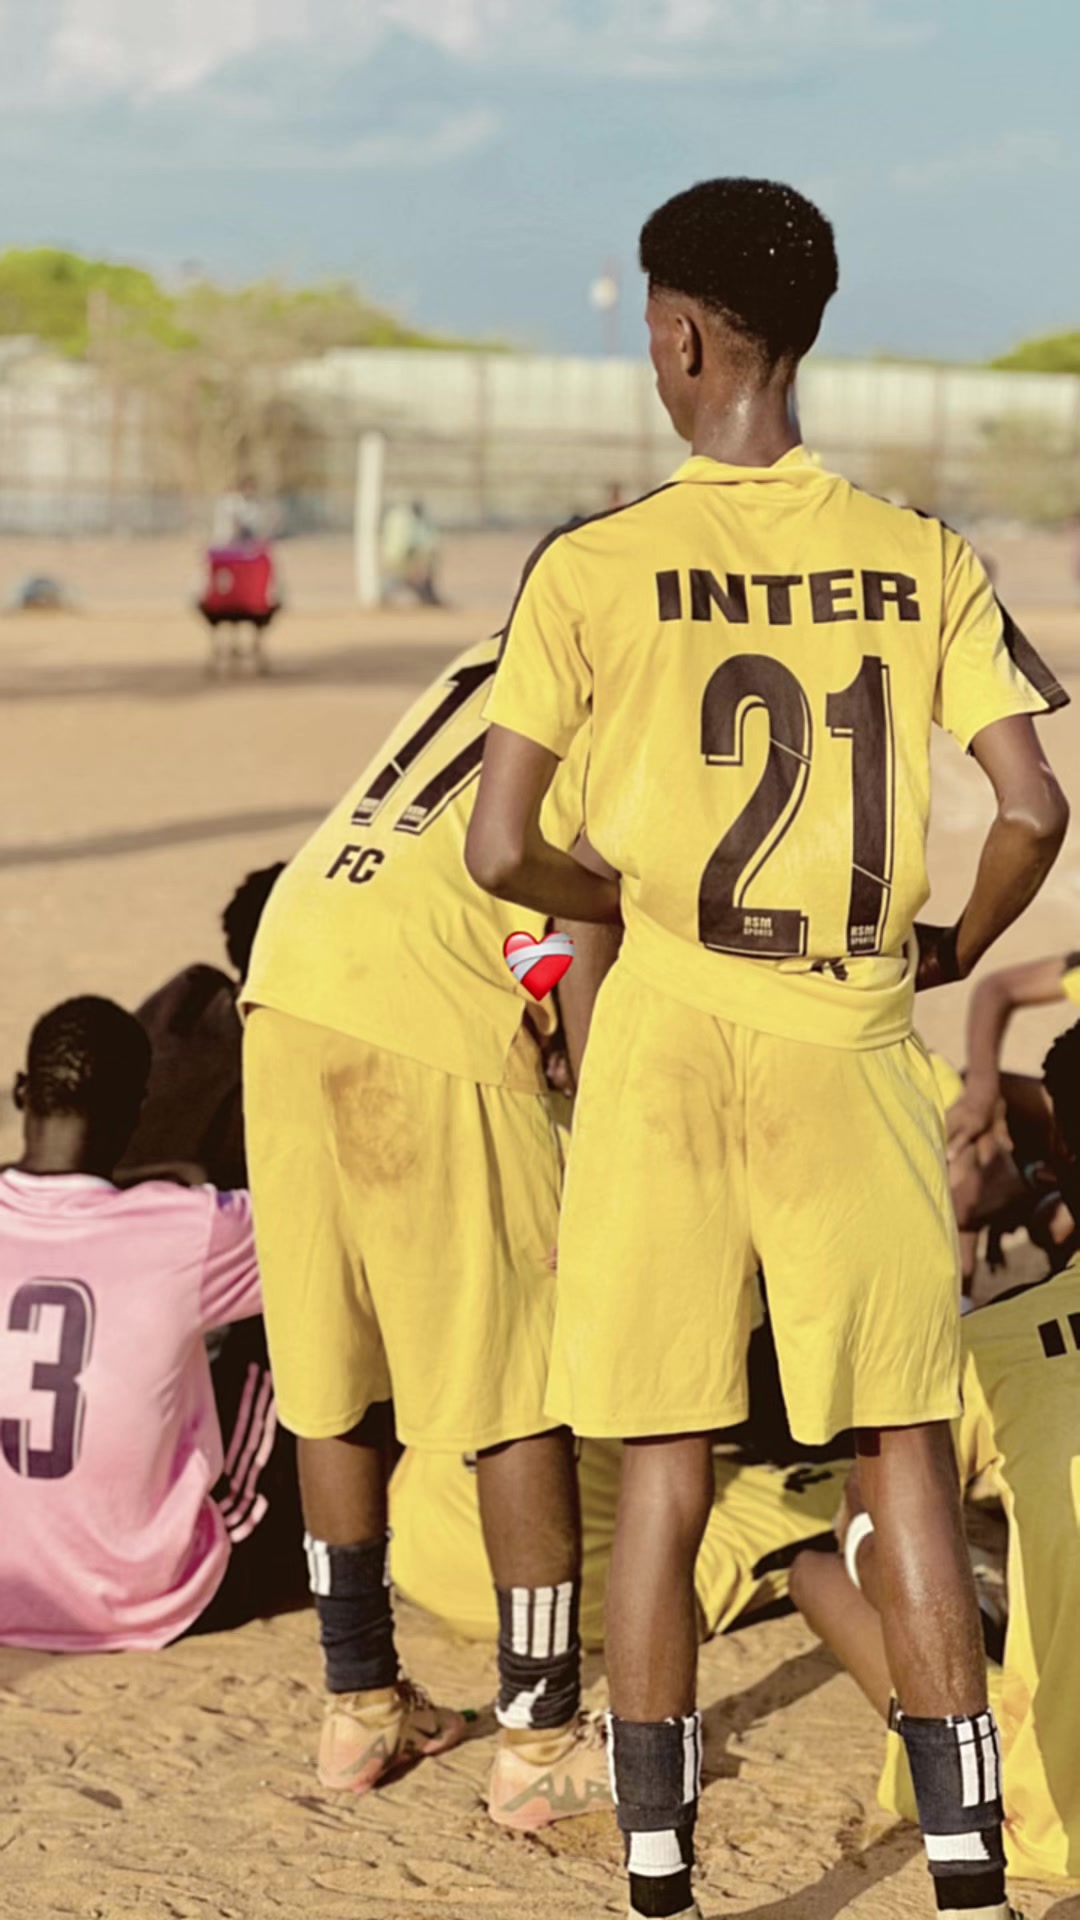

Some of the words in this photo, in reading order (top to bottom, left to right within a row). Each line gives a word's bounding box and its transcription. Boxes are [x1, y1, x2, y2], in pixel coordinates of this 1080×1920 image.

[655, 568, 921, 625] INTER
[698, 654, 895, 957] 21
[325, 844, 385, 884] FC
[743, 928, 774, 937] SPORTS
[744, 916, 772, 928] RSM
[851, 925, 875, 937] RSM
[1037, 1312, 1080, 1358] I
[0, 1276, 96, 1480] 3
